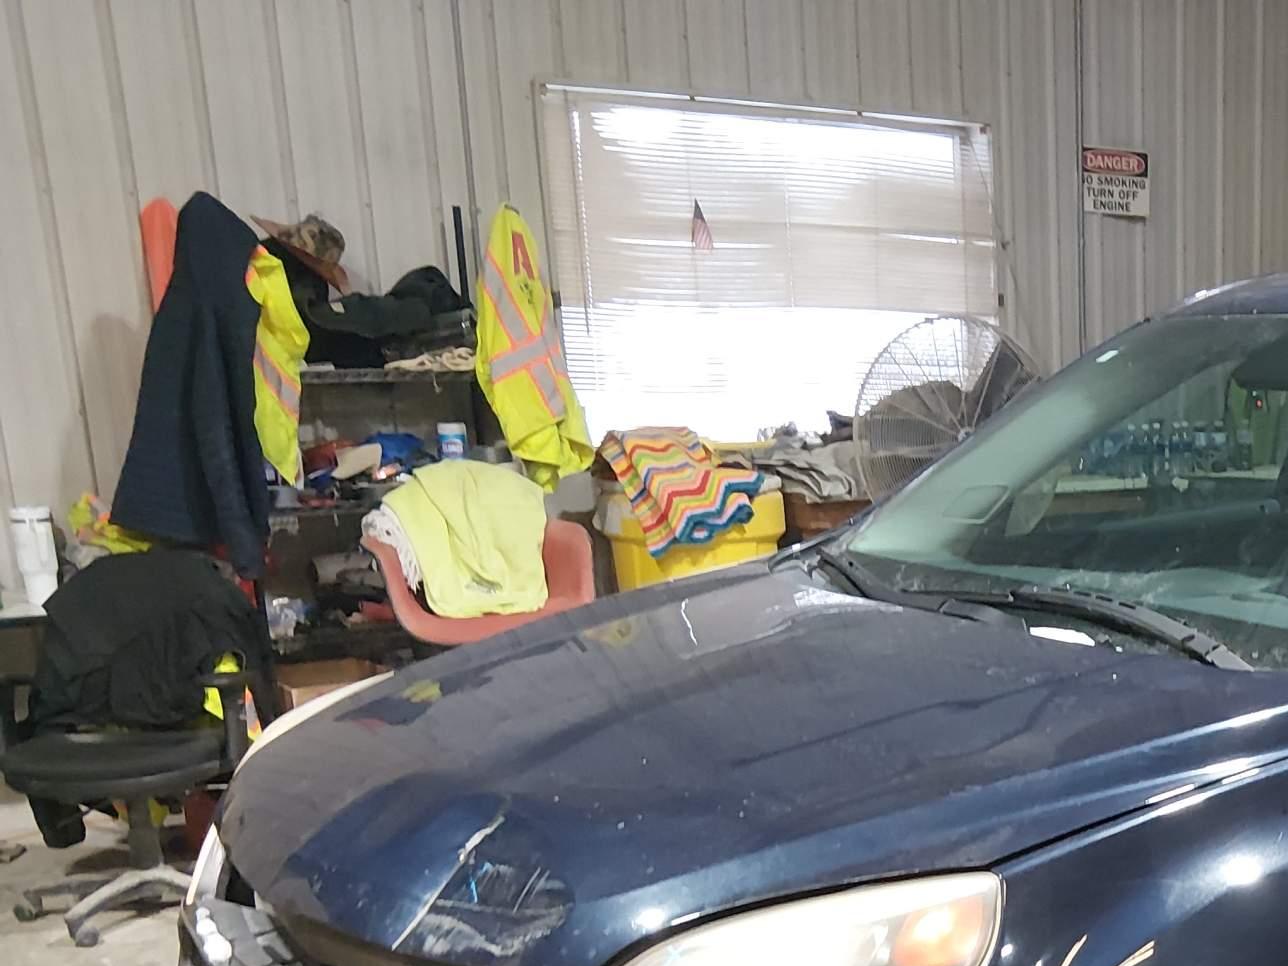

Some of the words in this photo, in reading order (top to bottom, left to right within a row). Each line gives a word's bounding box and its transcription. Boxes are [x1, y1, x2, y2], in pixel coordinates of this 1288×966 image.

[1087, 154, 1138, 171] DANGER
[1097, 176, 1146, 190] SMOKING
[1087, 187, 1114, 198] TURN
[1119, 190, 1139, 201] OFF
[1093, 200, 1132, 212] ENGINE
